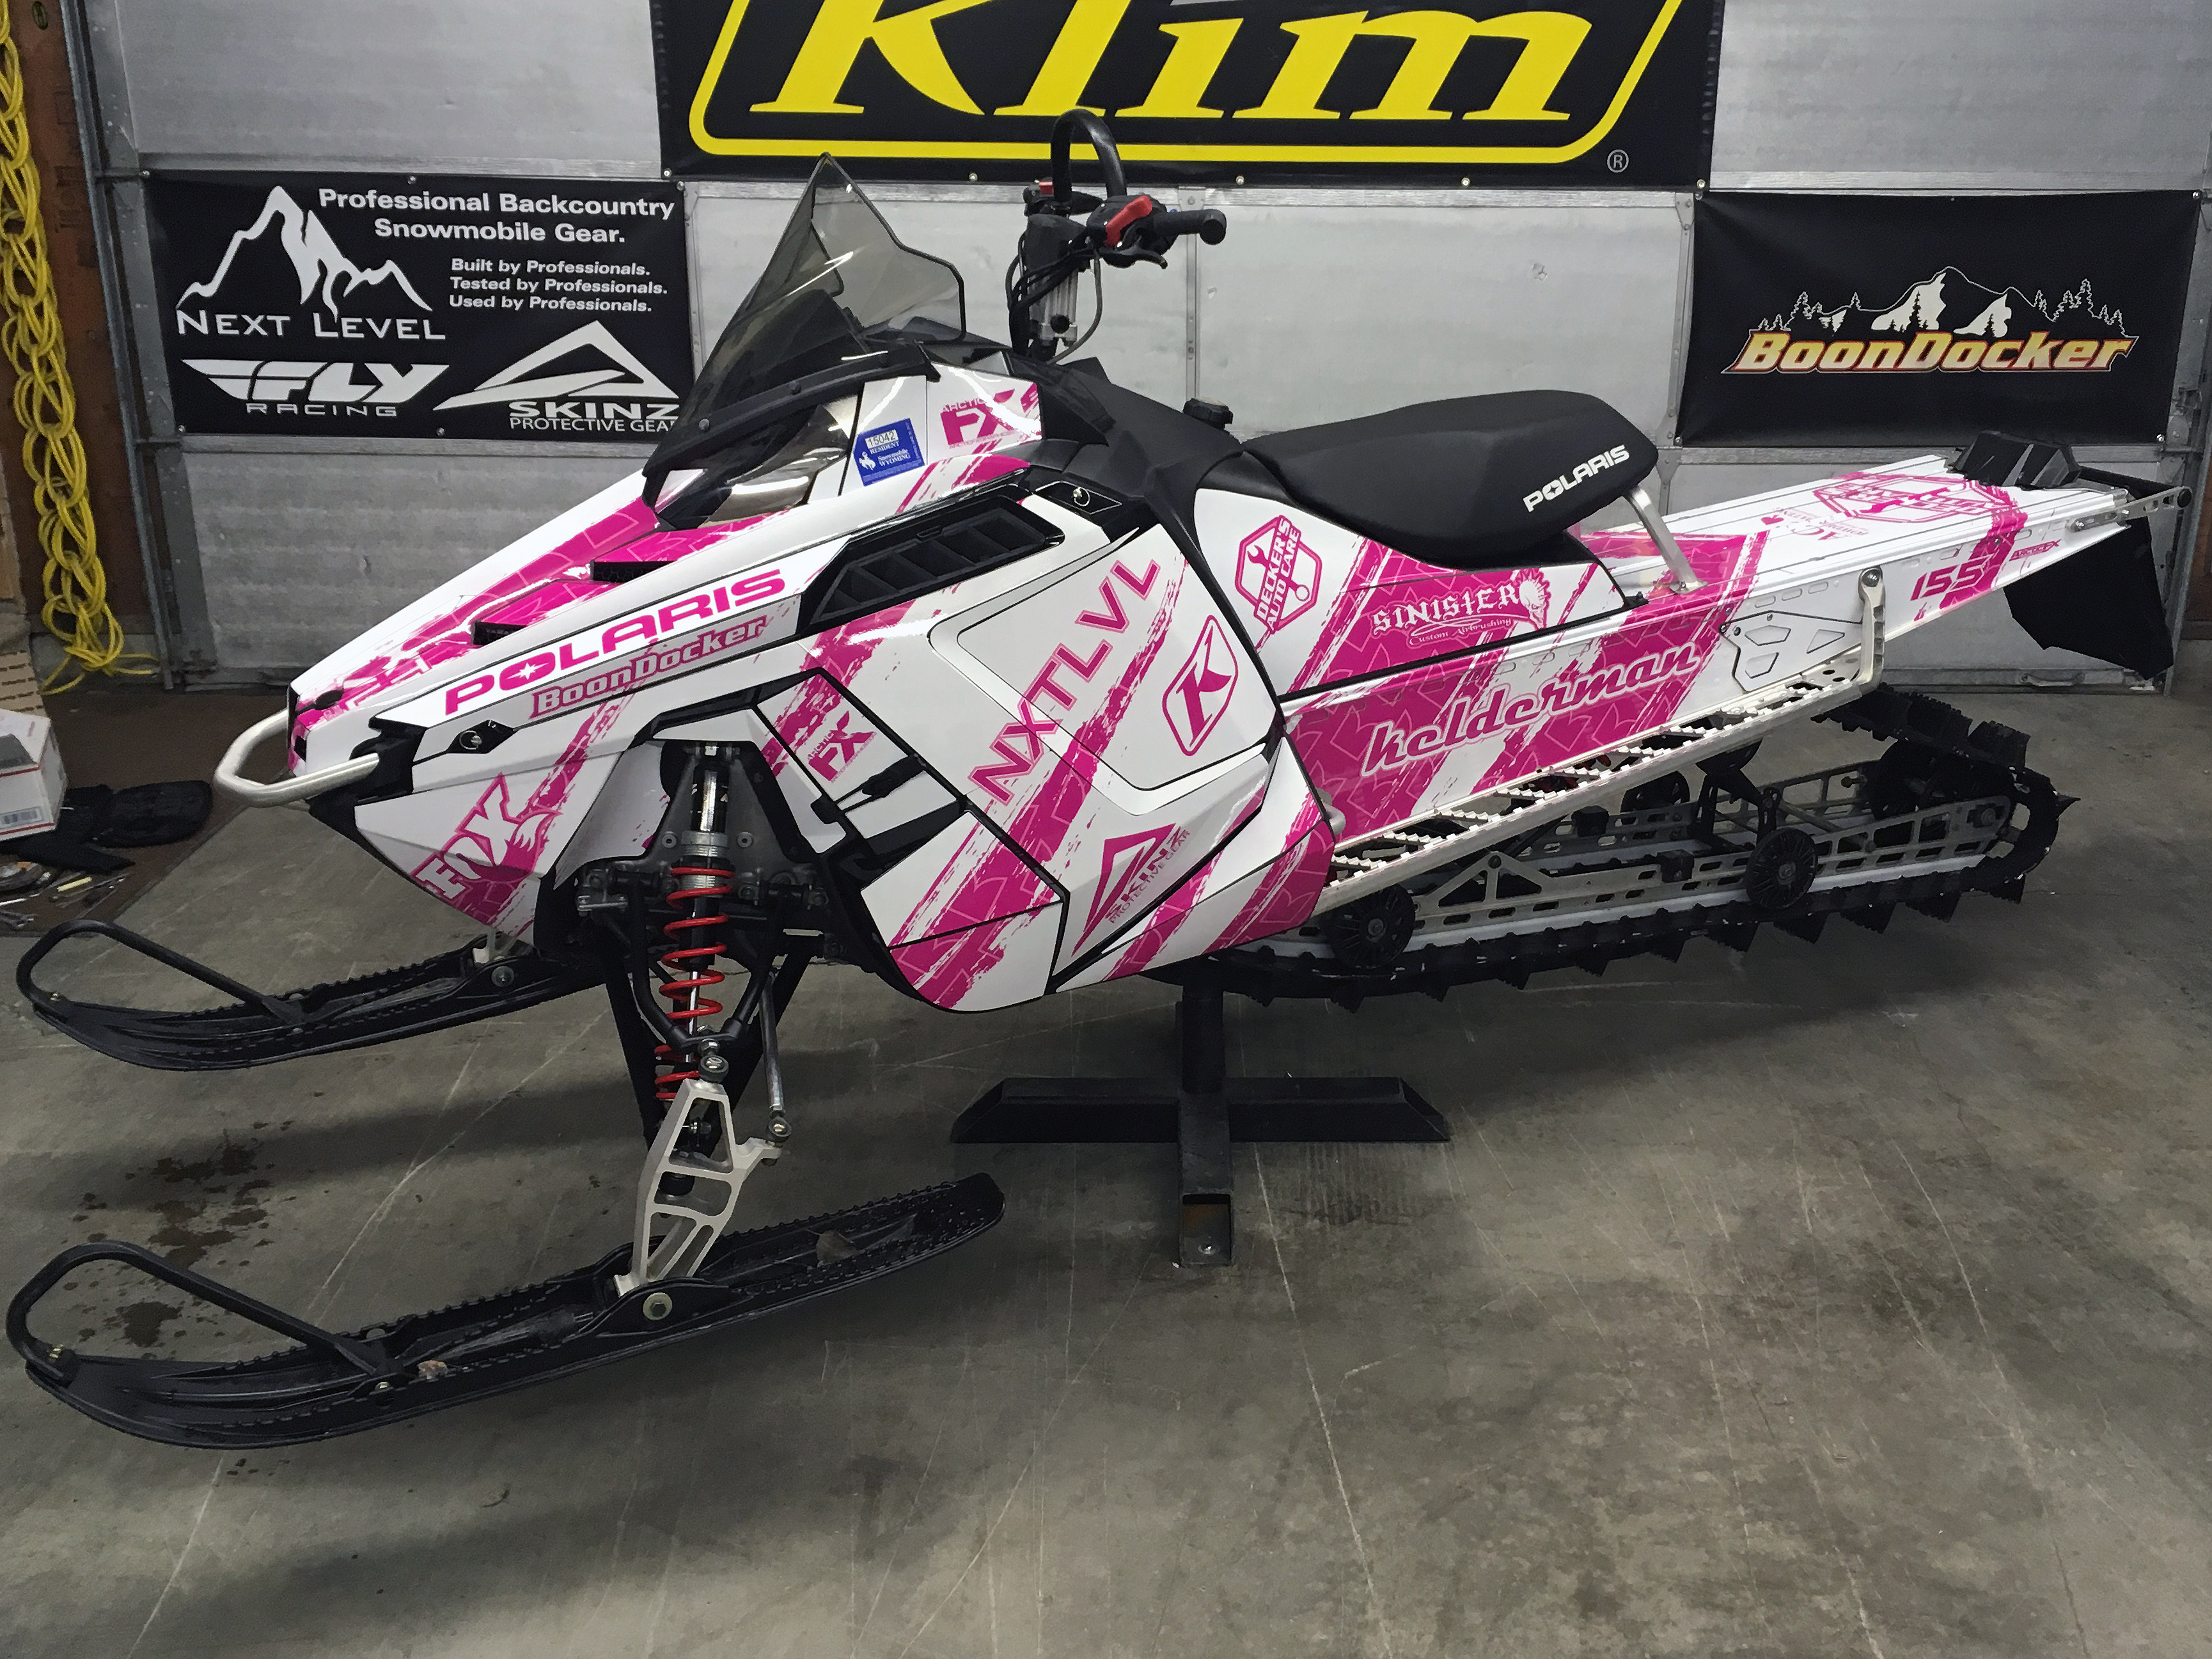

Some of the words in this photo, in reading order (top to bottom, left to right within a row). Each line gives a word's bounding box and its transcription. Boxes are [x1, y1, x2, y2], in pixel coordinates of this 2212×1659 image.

[750, 0, 1593, 120] Klim
[319, 188, 490, 212] Professional
[499, 193, 675, 220] Backcountry
[375, 218, 546, 241] Snowmobile
[554, 223, 625, 243] Gear.
[450, 276, 510, 290] Tested
[516, 277, 539, 294] by
[544, 278, 668, 295] Professionals.
[451, 258, 493, 272] Built
[498, 259, 520, 275] by
[526, 260, 650, 276] Professionals.
[449, 294, 496, 308] Used
[501, 295, 524, 311] by
[529, 296, 652, 313] Professionals.
[1727, 331, 2136, 373] BoonDocker
[182, 359, 450, 404] FLY
[246, 402, 397, 417] RACING
[509, 400, 680, 420] SKINZ
[510, 417, 625, 431] PROTECTIVE
[868, 430, 896, 447] 15042
[879, 453, 911, 467] WYOMING
[1523, 444, 1630, 512] POLARIS
[1256, 517, 1292, 621] DECKER'S
[1267, 578, 1287, 631] AUTO
[1280, 527, 1300, 578] CARE
[1910, 554, 1993, 601] 155
[1372, 583, 1520, 635] SINISTER
[1409, 631, 1449, 645] Custom
[1452, 617, 1512, 638] Airbrushing
[445, 569, 786, 716] POLARIS
[529, 615, 767, 719] BoonDocker
[968, 558, 1161, 806] NXTLVL
[1177, 625, 1232, 748] K
[1361, 642, 1701, 776] kelderman
[412, 775, 529, 900] FOX
[1104, 826, 1182, 919] SKINZ
[1108, 861, 1166, 924] PROTECTIVE
[1165, 829, 1191, 861] GEAR
